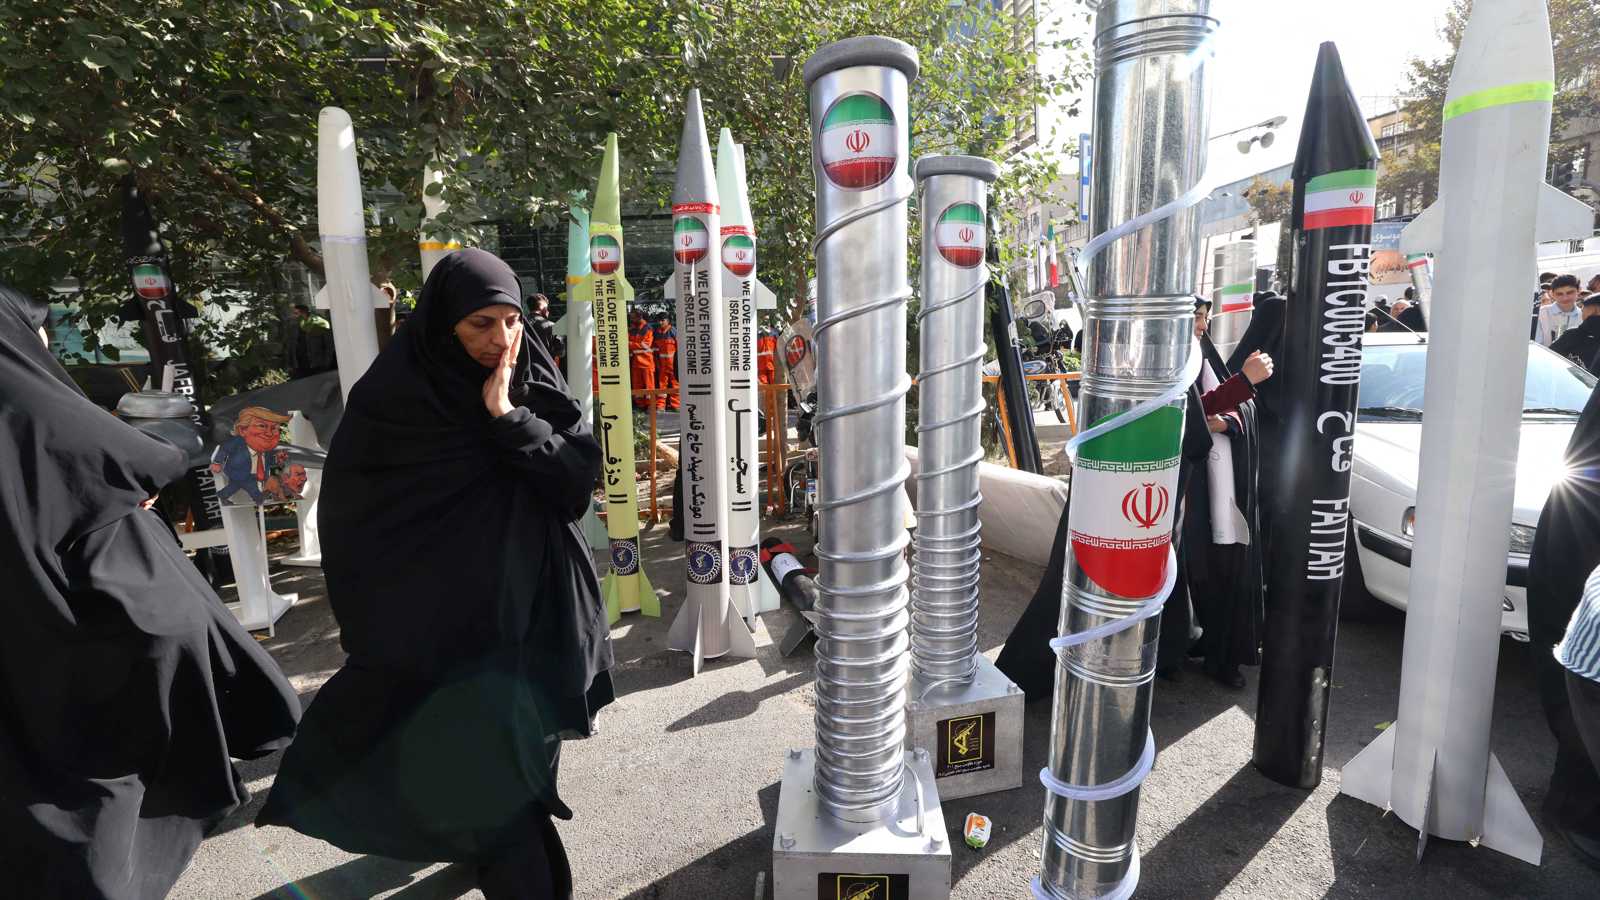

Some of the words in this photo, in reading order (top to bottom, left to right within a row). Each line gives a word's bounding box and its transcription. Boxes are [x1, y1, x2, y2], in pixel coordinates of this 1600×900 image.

[595, 279, 604, 296] THE
[606, 279, 616, 294] WE
[697, 270, 709, 288] WE
[741, 280, 751, 295] WE
[596, 299, 605, 332] ISRAELI
[607, 298, 617, 322] LOVE
[684, 293, 696, 333] ISRAELI
[698, 292, 710, 321] LOVE
[729, 300, 739, 334] ISRAELI
[742, 299, 751, 326] LOVE
[1319, 243, 1371, 385] FB1C005400
[598, 334, 608, 368] REGIME
[608, 324, 620, 368] FIGHTING
[686, 336, 697, 375] REGIME
[699, 324, 712, 375] FIGHTING
[729, 337, 740, 371] REGIME
[742, 329, 751, 371] FIGHTING
[686, 403, 705, 430] قاسم
[600, 402, 622, 486] دزفول
[687, 432, 703, 454] حاج
[1316, 411, 1355, 473] فتاح
[687, 457, 705, 482] شهید
[689, 484, 707, 519] موشک
